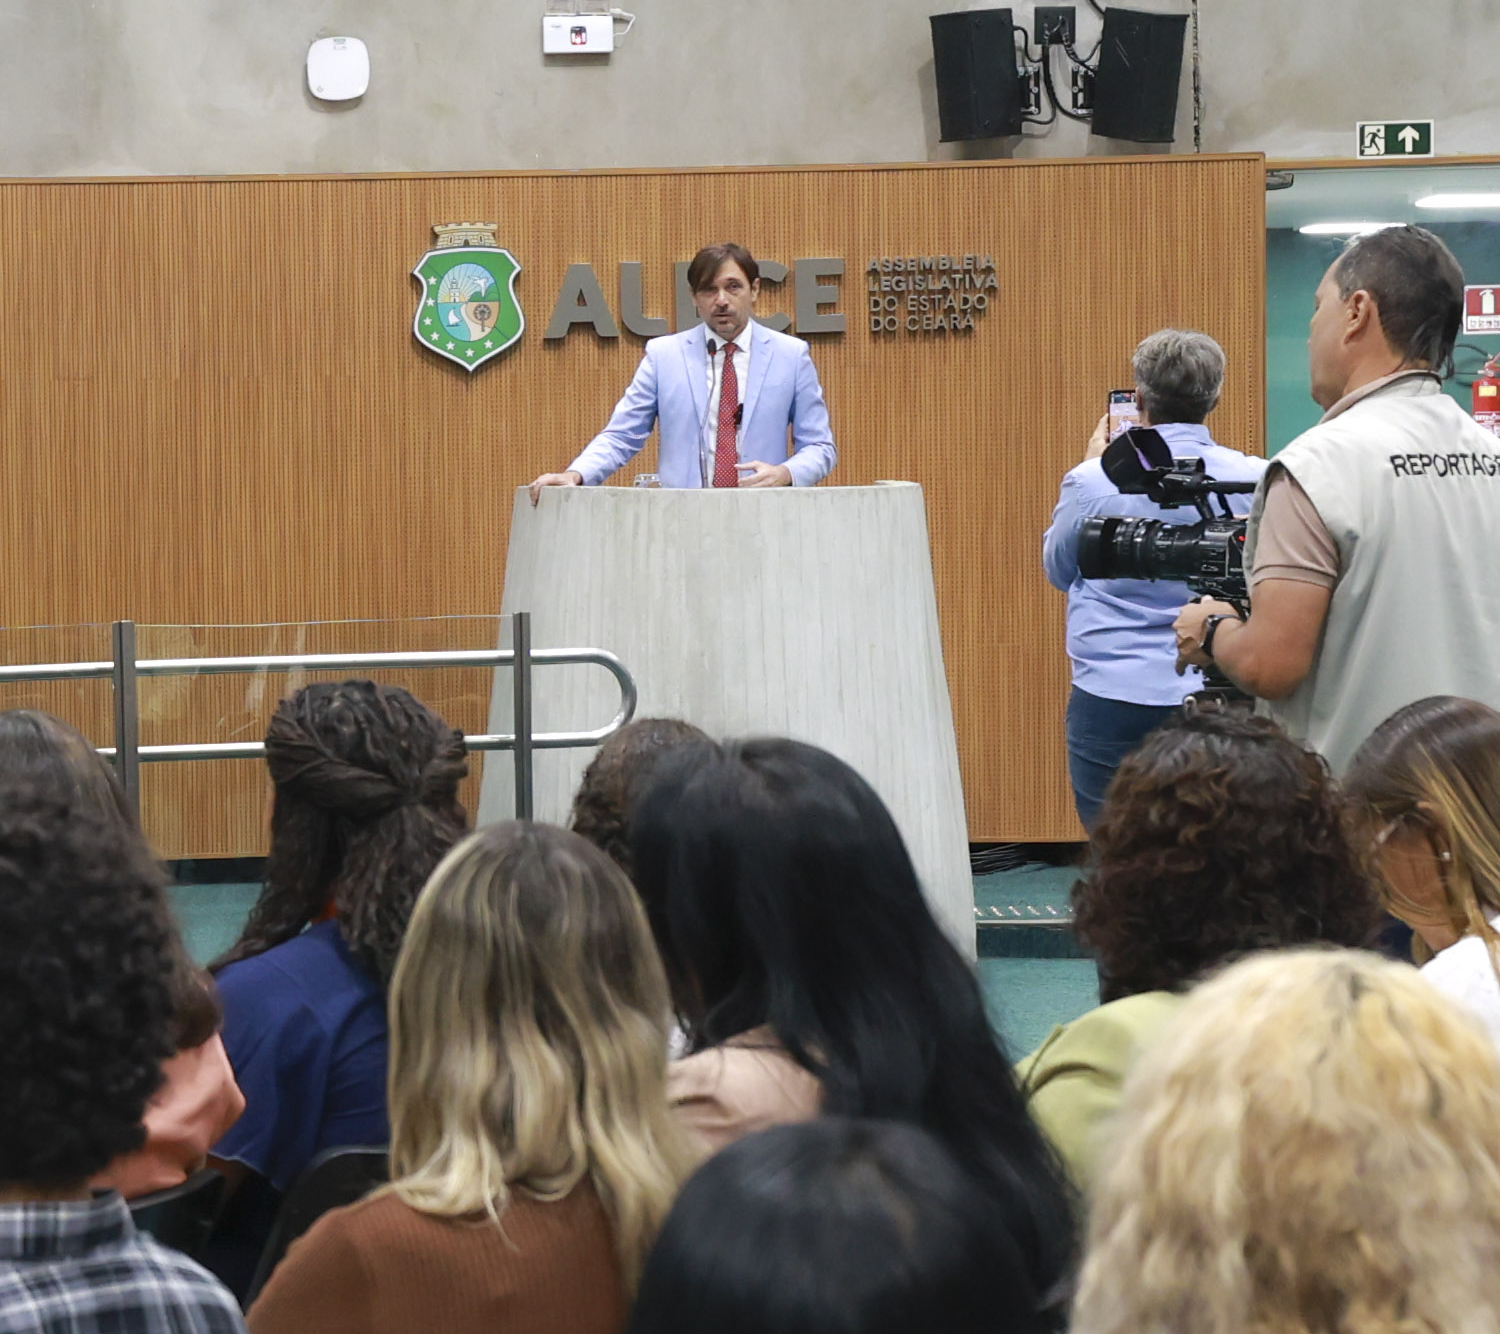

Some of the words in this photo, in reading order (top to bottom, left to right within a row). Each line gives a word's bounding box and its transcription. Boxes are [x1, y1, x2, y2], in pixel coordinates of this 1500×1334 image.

[867, 254, 996, 272] ASSEMBLEIA
[868, 273, 998, 291] LEGISLATIVA
[870, 296, 898, 311] DO
[907, 293, 988, 310] ESTADO
[871, 316, 898, 331] DO
[906, 309, 975, 330] CEARÁ
